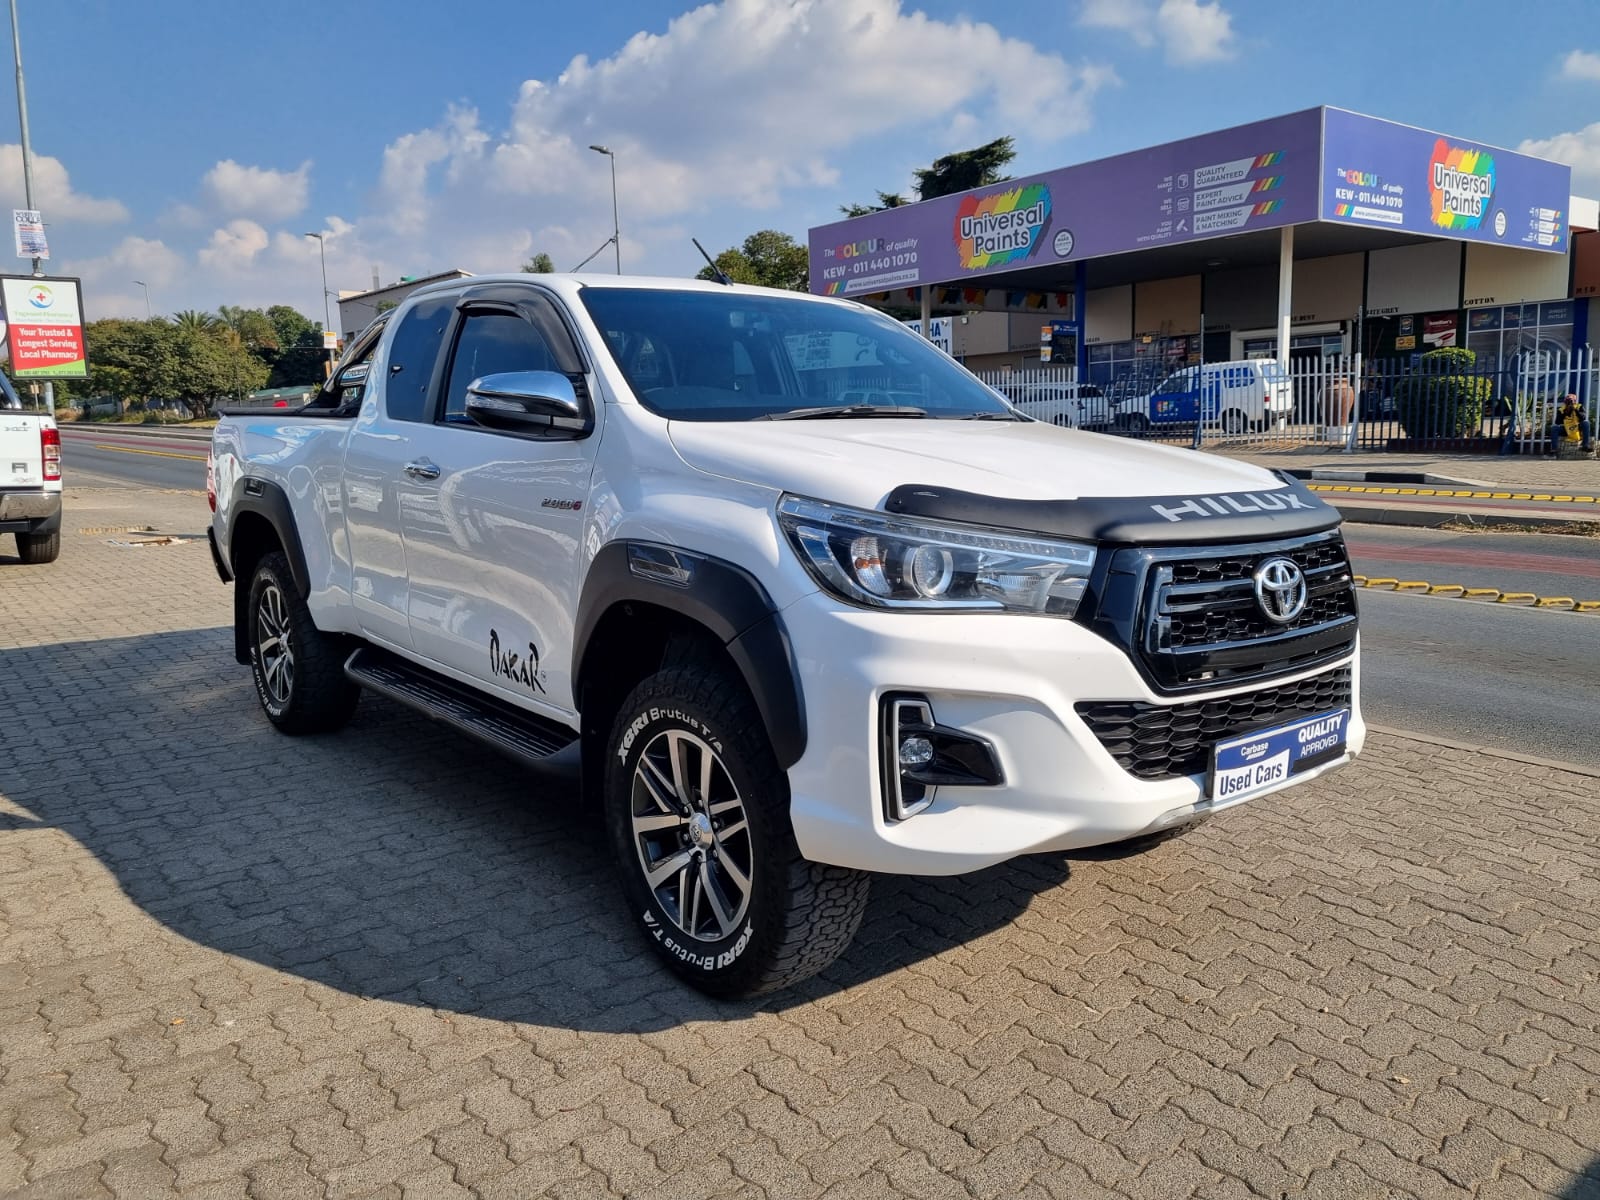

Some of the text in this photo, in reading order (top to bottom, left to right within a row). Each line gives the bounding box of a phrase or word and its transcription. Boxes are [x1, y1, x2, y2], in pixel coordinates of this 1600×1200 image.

[1197, 166, 1226, 178] QUALITY
[1197, 170, 1244, 185] GUARANTEED
[1435, 164, 1490, 195] Universal
[1196, 190, 1223, 200] EXPERT
[1196, 194, 1243, 209] PAINT ADVICE
[1335, 188, 1354, 200] KEW
[1359, 192, 1370, 203] 011
[1371, 194, 1385, 205] 440
[1386, 196, 1403, 208] 1070
[1443, 190, 1481, 215] Paints
[962, 202, 1043, 237] Universal
[1202, 218, 1238, 230] MATCHING
[1217, 209, 1243, 219] MIXING
[824, 238, 919, 260] The COLOUR of quality
[975, 229, 1029, 254] Paints
[823, 265, 846, 279] KEW
[853, 261, 868, 274] 011
[870, 257, 890, 270] 440
[892, 252, 918, 266] 1070
[1463, 297, 1495, 306] COTTON
[19, 327, 73, 337] Your Trusted &
[17, 339, 78, 349] Longest Serving
[20, 349, 78, 360] Local Pharmacy
[1150, 493, 1317, 522] HILUX
[490, 628, 546, 695] DAKAR
[617, 707, 723, 767] XBRI Brutus T/A
[1298, 714, 1343, 743] QUALITY
[1240, 742, 1269, 756] Carbase
[1301, 734, 1338, 757] APPROVED
[1220, 763, 1283, 796] Used Cars
[643, 910, 754, 970] XBRI Brutus T/A
